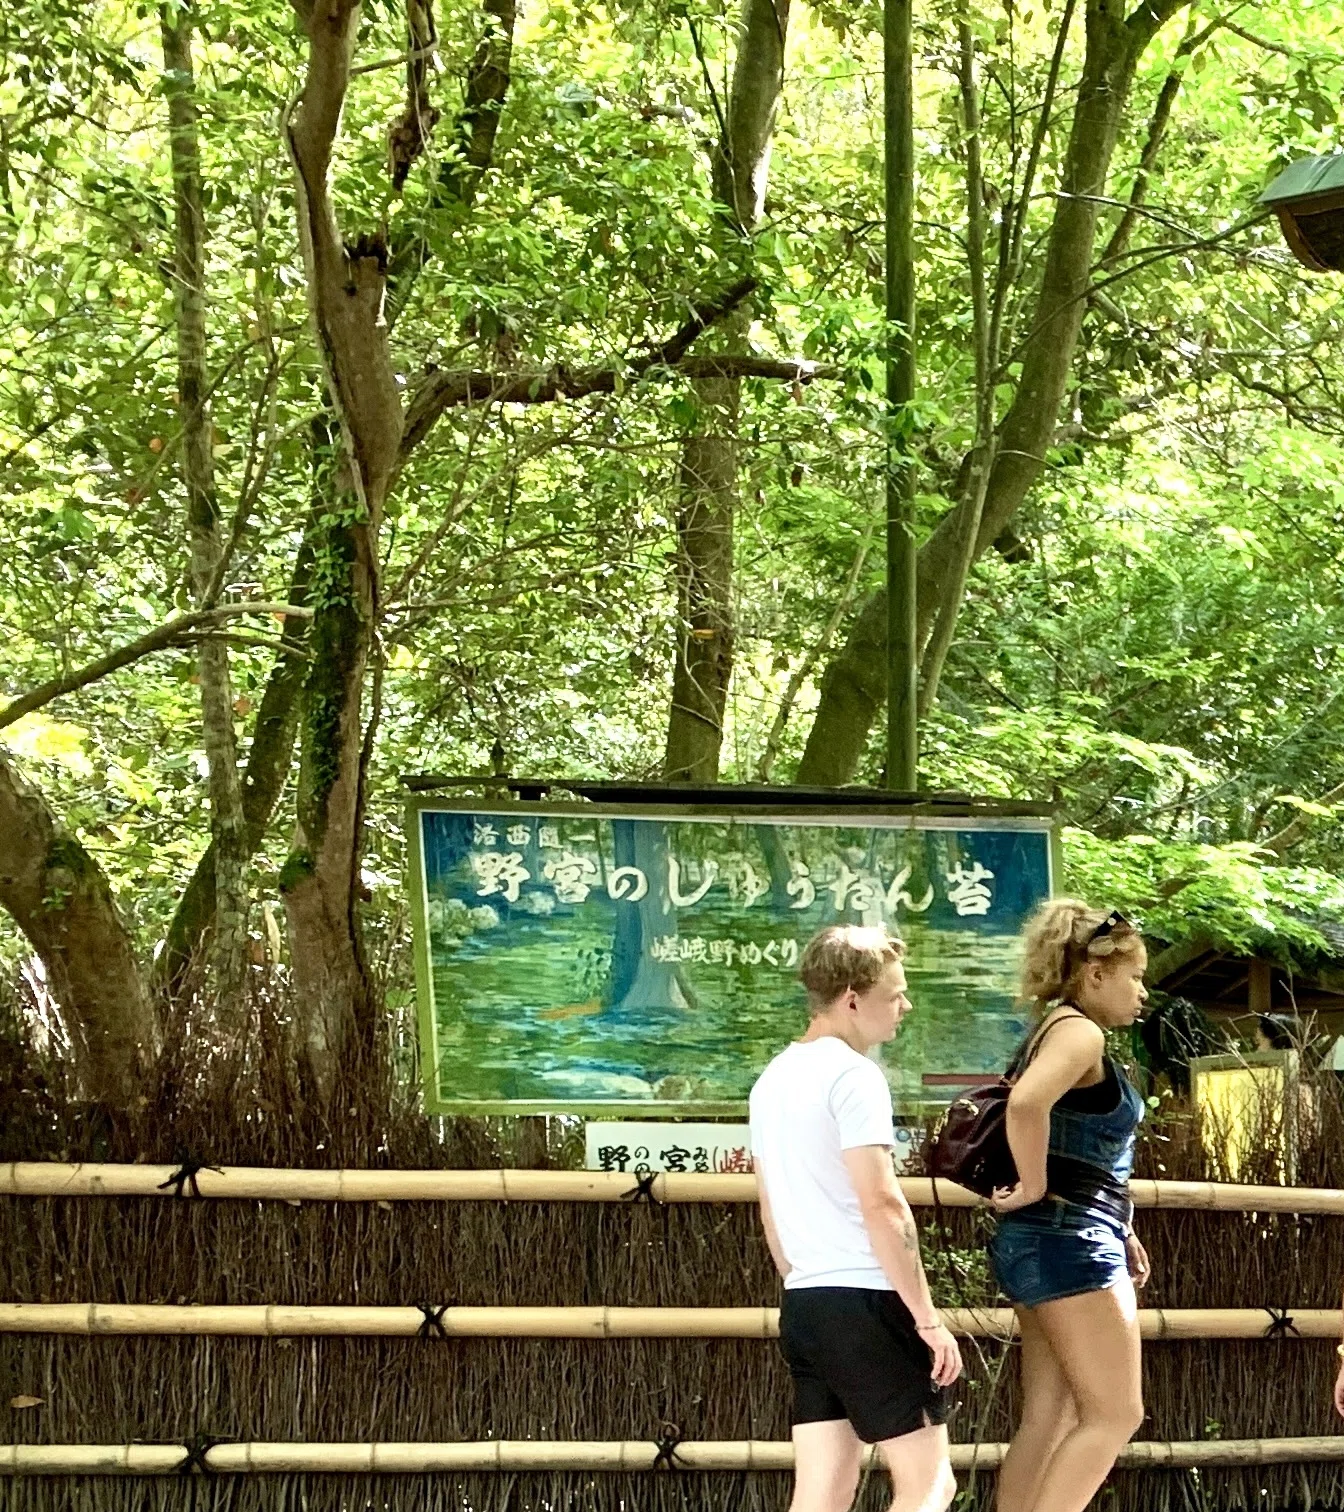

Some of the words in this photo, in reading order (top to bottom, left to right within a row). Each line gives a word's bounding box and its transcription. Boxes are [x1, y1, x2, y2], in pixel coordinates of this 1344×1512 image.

[473, 850, 995, 917] 野宮のじゅうたん苔
[650, 933, 799, 968] 嵯峨野めぐり
